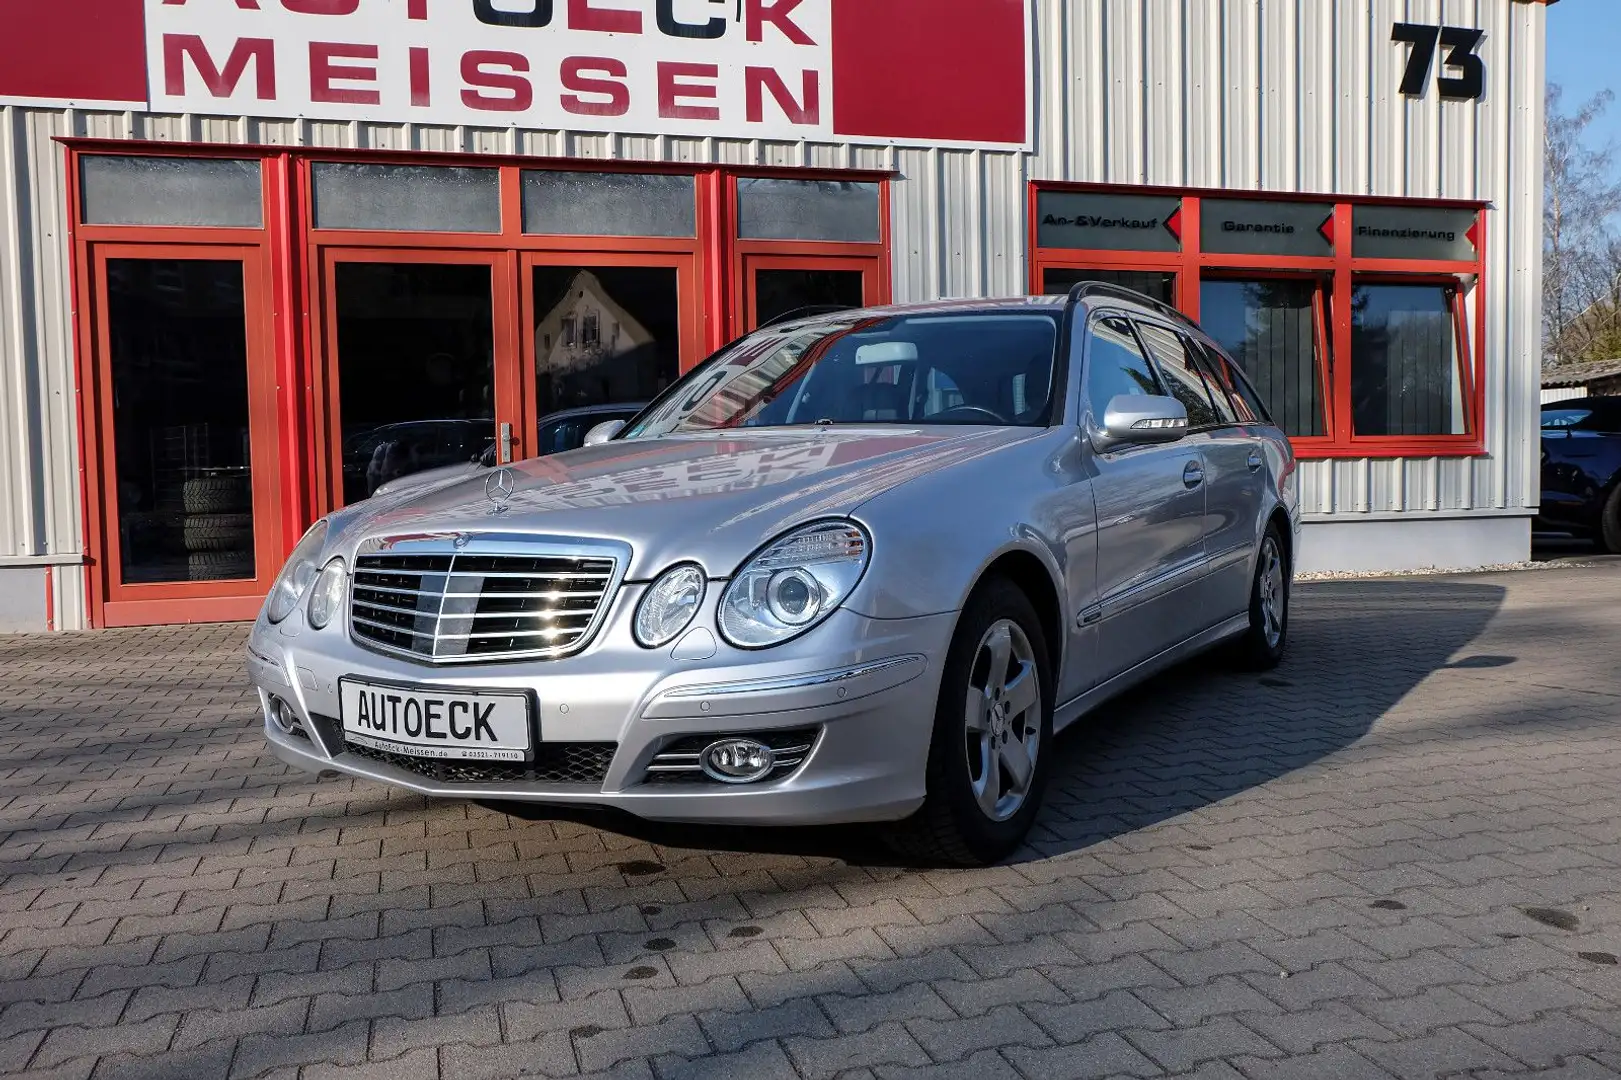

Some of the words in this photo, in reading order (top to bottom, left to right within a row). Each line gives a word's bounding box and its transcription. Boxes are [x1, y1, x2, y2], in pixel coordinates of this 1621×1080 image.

[163, 33, 819, 126] MEISSEN
[1391, 23, 1484, 98] 73
[1222, 220, 1294, 234] Garantie
[1356, 226, 1455, 241] Finanzierung
[358, 689, 498, 742] AUTOECK
